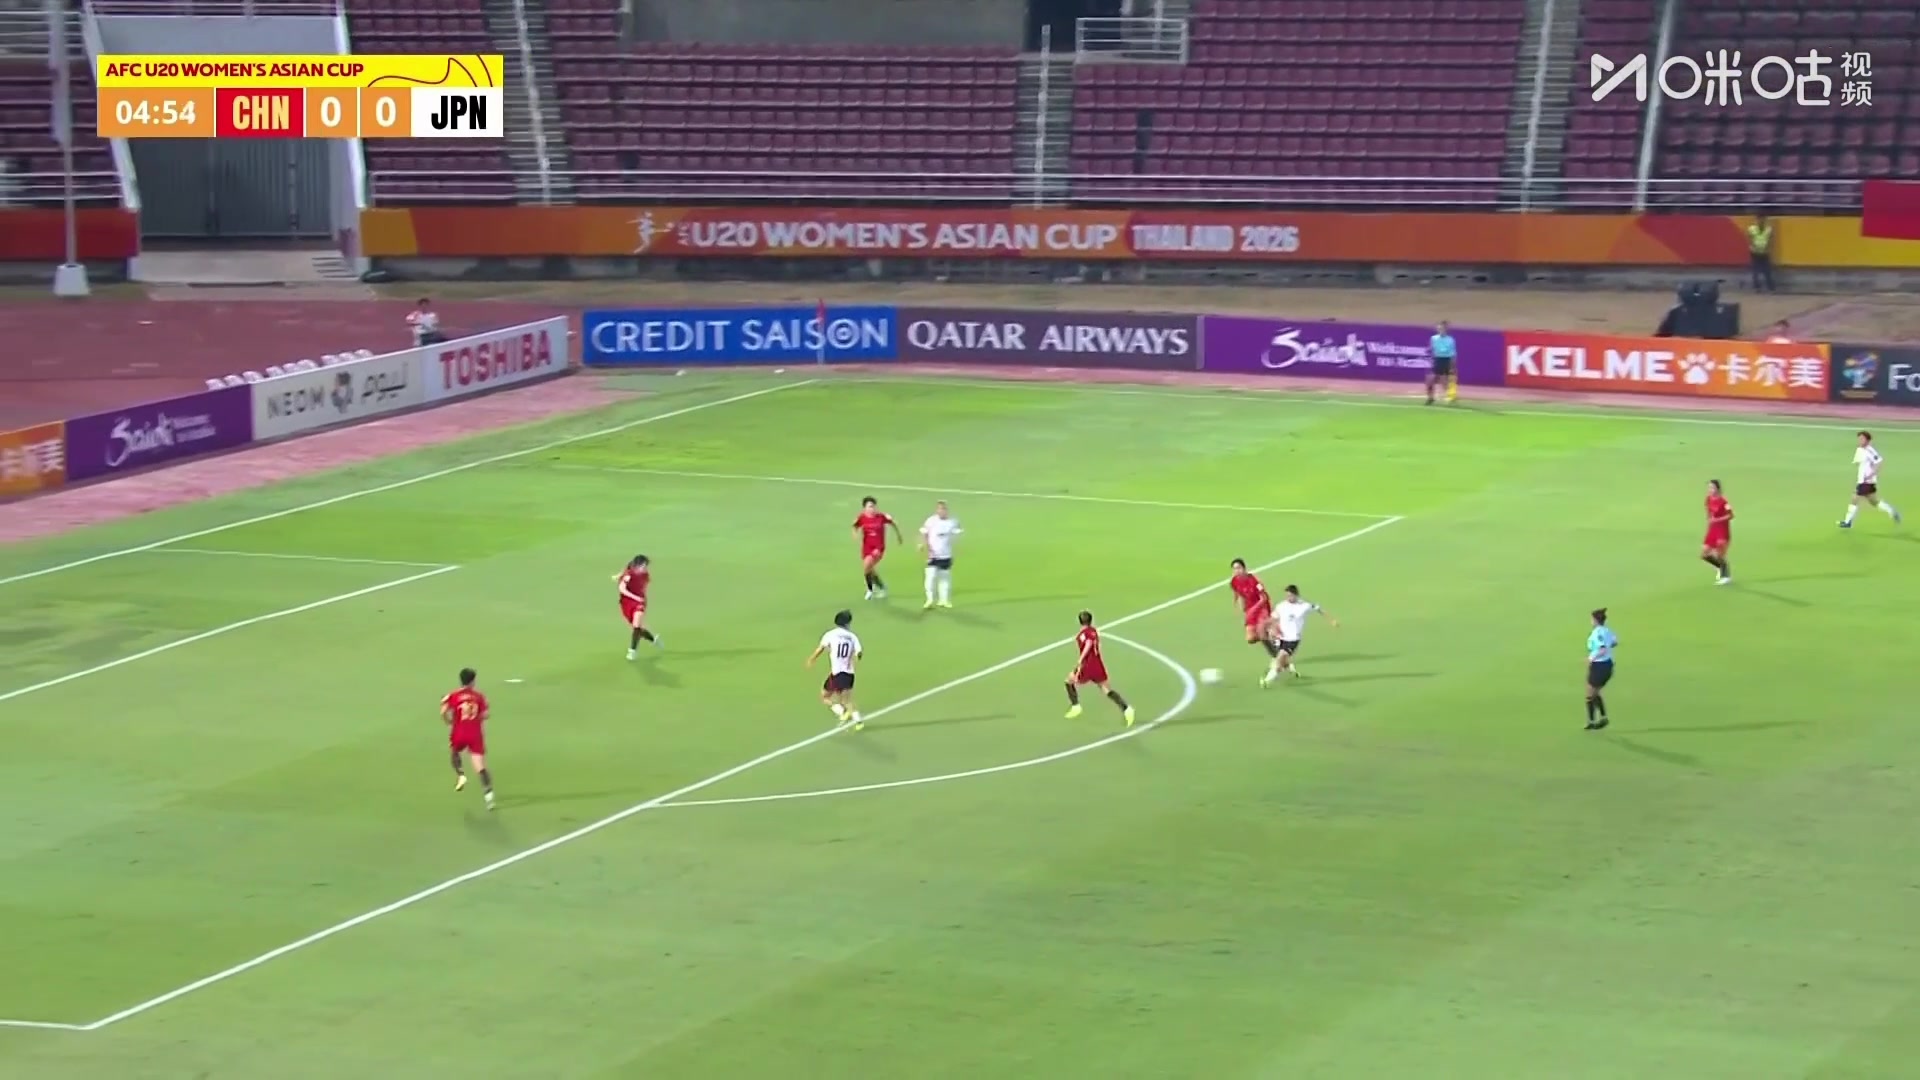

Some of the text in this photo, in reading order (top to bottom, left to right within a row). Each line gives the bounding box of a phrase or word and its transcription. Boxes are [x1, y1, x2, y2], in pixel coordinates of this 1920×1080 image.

[692, 221, 758, 247] U20
[762, 221, 928, 249] WOMEN'S
[933, 223, 1039, 249] ASIAN
[1044, 223, 1118, 251] CUP
[591, 317, 890, 353] CREDIT SAISON
[907, 319, 1189, 355] QATAR AIRWAYS
[440, 330, 552, 390] TOSHIBA
[1506, 345, 1674, 384] KELME
[1717, 353, 1825, 390] 卡尔美
[1888, 363, 1920, 392] Fo
[267, 385, 325, 420] NEOM
[837, 642, 849, 658] 10
